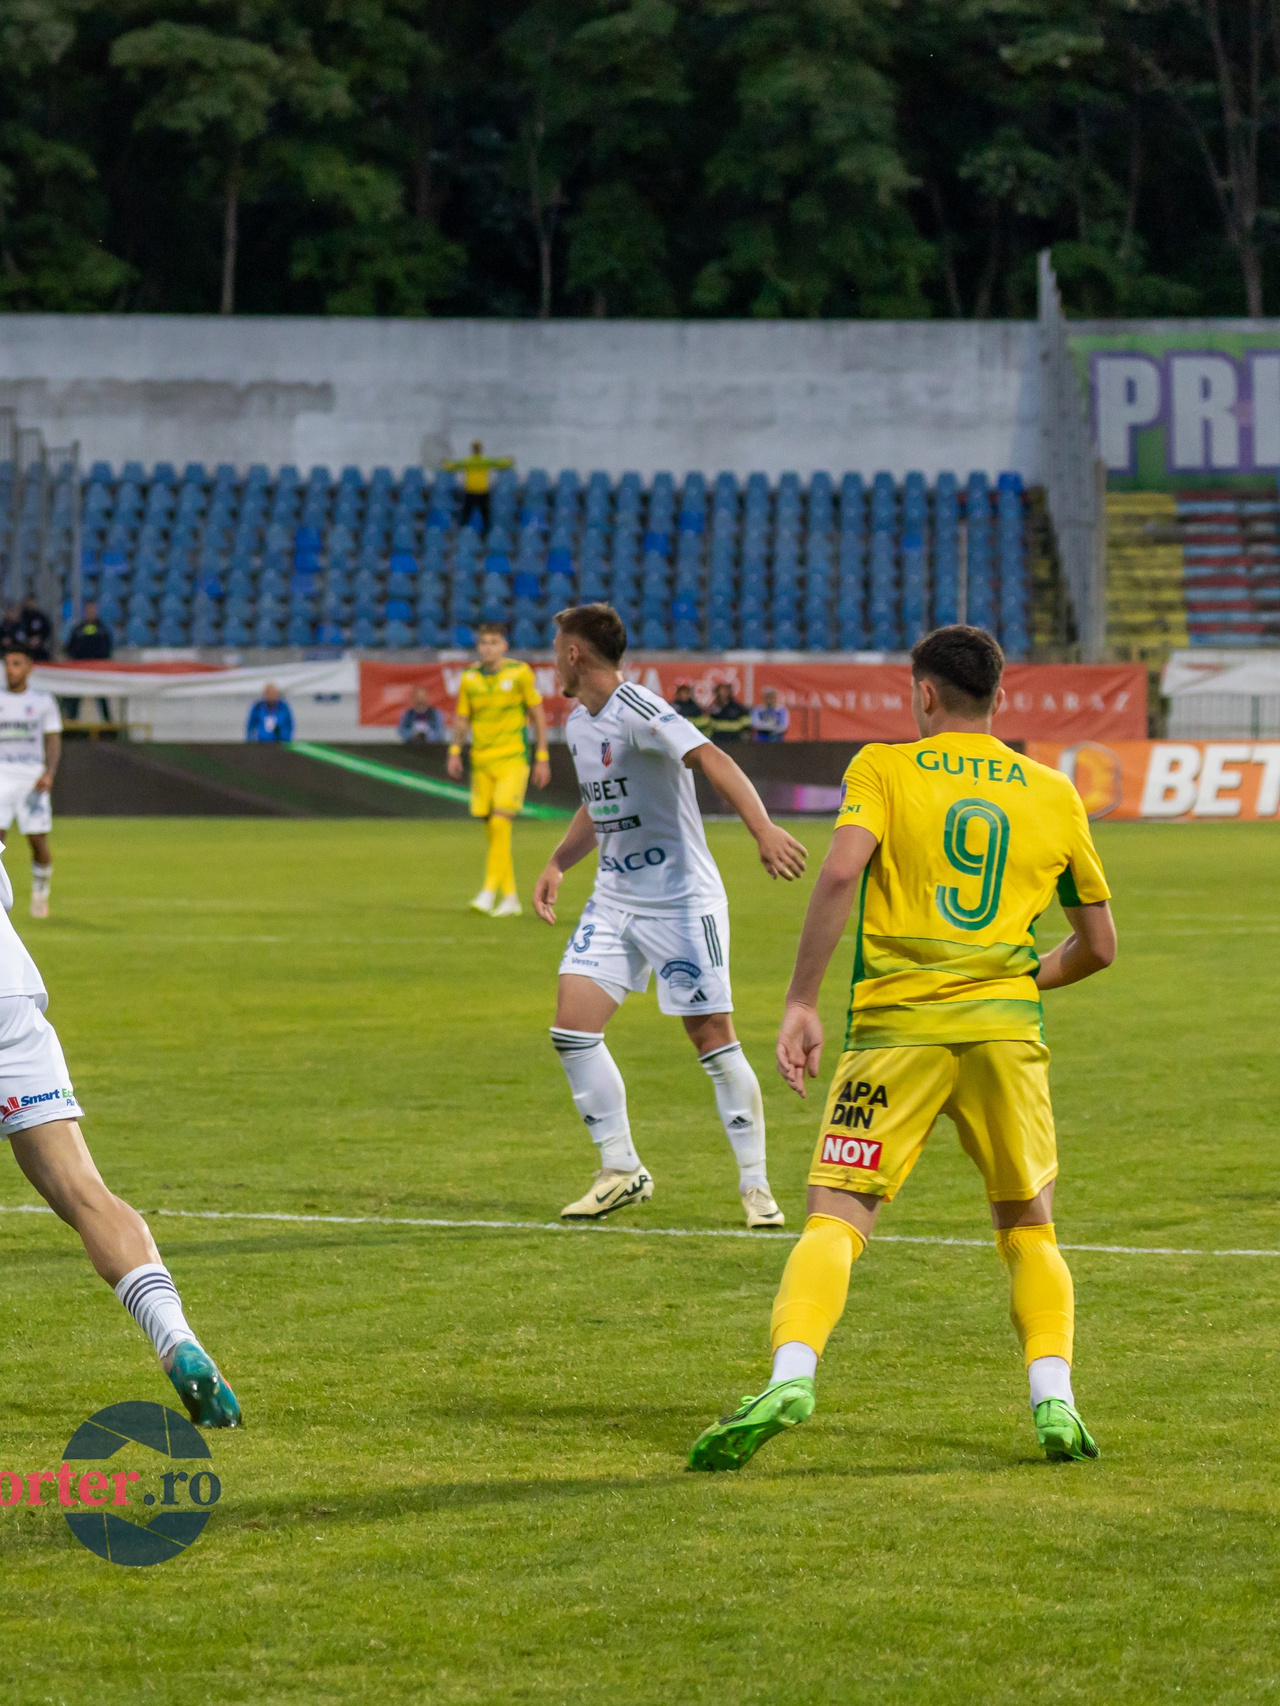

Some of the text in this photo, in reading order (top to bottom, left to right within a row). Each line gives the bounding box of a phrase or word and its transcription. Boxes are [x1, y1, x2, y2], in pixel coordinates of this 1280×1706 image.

[916, 750, 1028, 787] GUȚEA
[581, 777, 628, 802] NIBET
[935, 797, 1010, 931] 9
[566, 922, 596, 953] 3
[21, 1089, 60, 1107] Smart
[837, 1081, 888, 1108] APA
[830, 1103, 874, 1129] DIN
[822, 1137, 879, 1167] NOY
